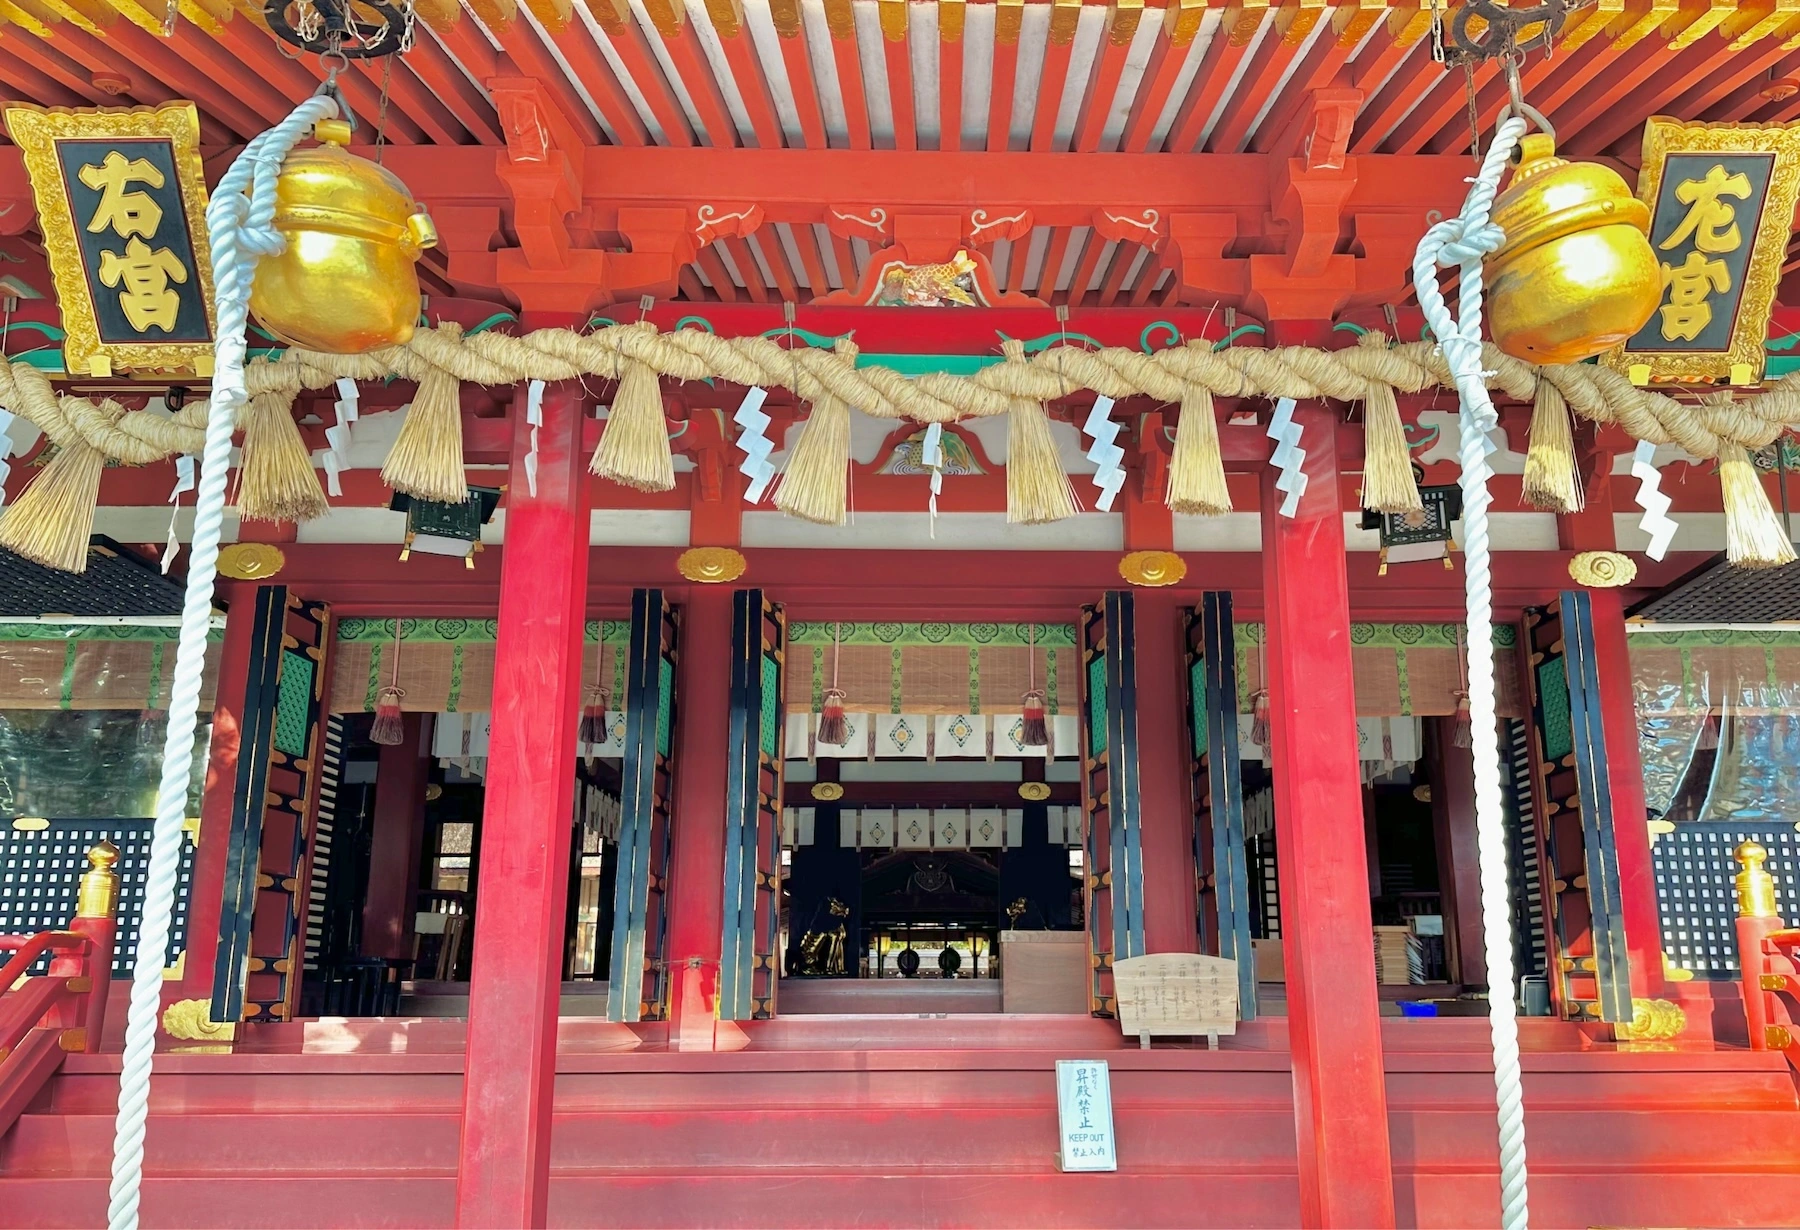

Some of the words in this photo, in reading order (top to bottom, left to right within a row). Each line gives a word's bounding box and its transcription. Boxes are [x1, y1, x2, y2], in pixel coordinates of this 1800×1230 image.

[78, 150, 188, 333] 右宮
[1075, 1067, 1094, 1129] 昇殿禁止
[1068, 1133, 1088, 1143] KEEP
[1090, 1133, 1104, 1142] OUT
